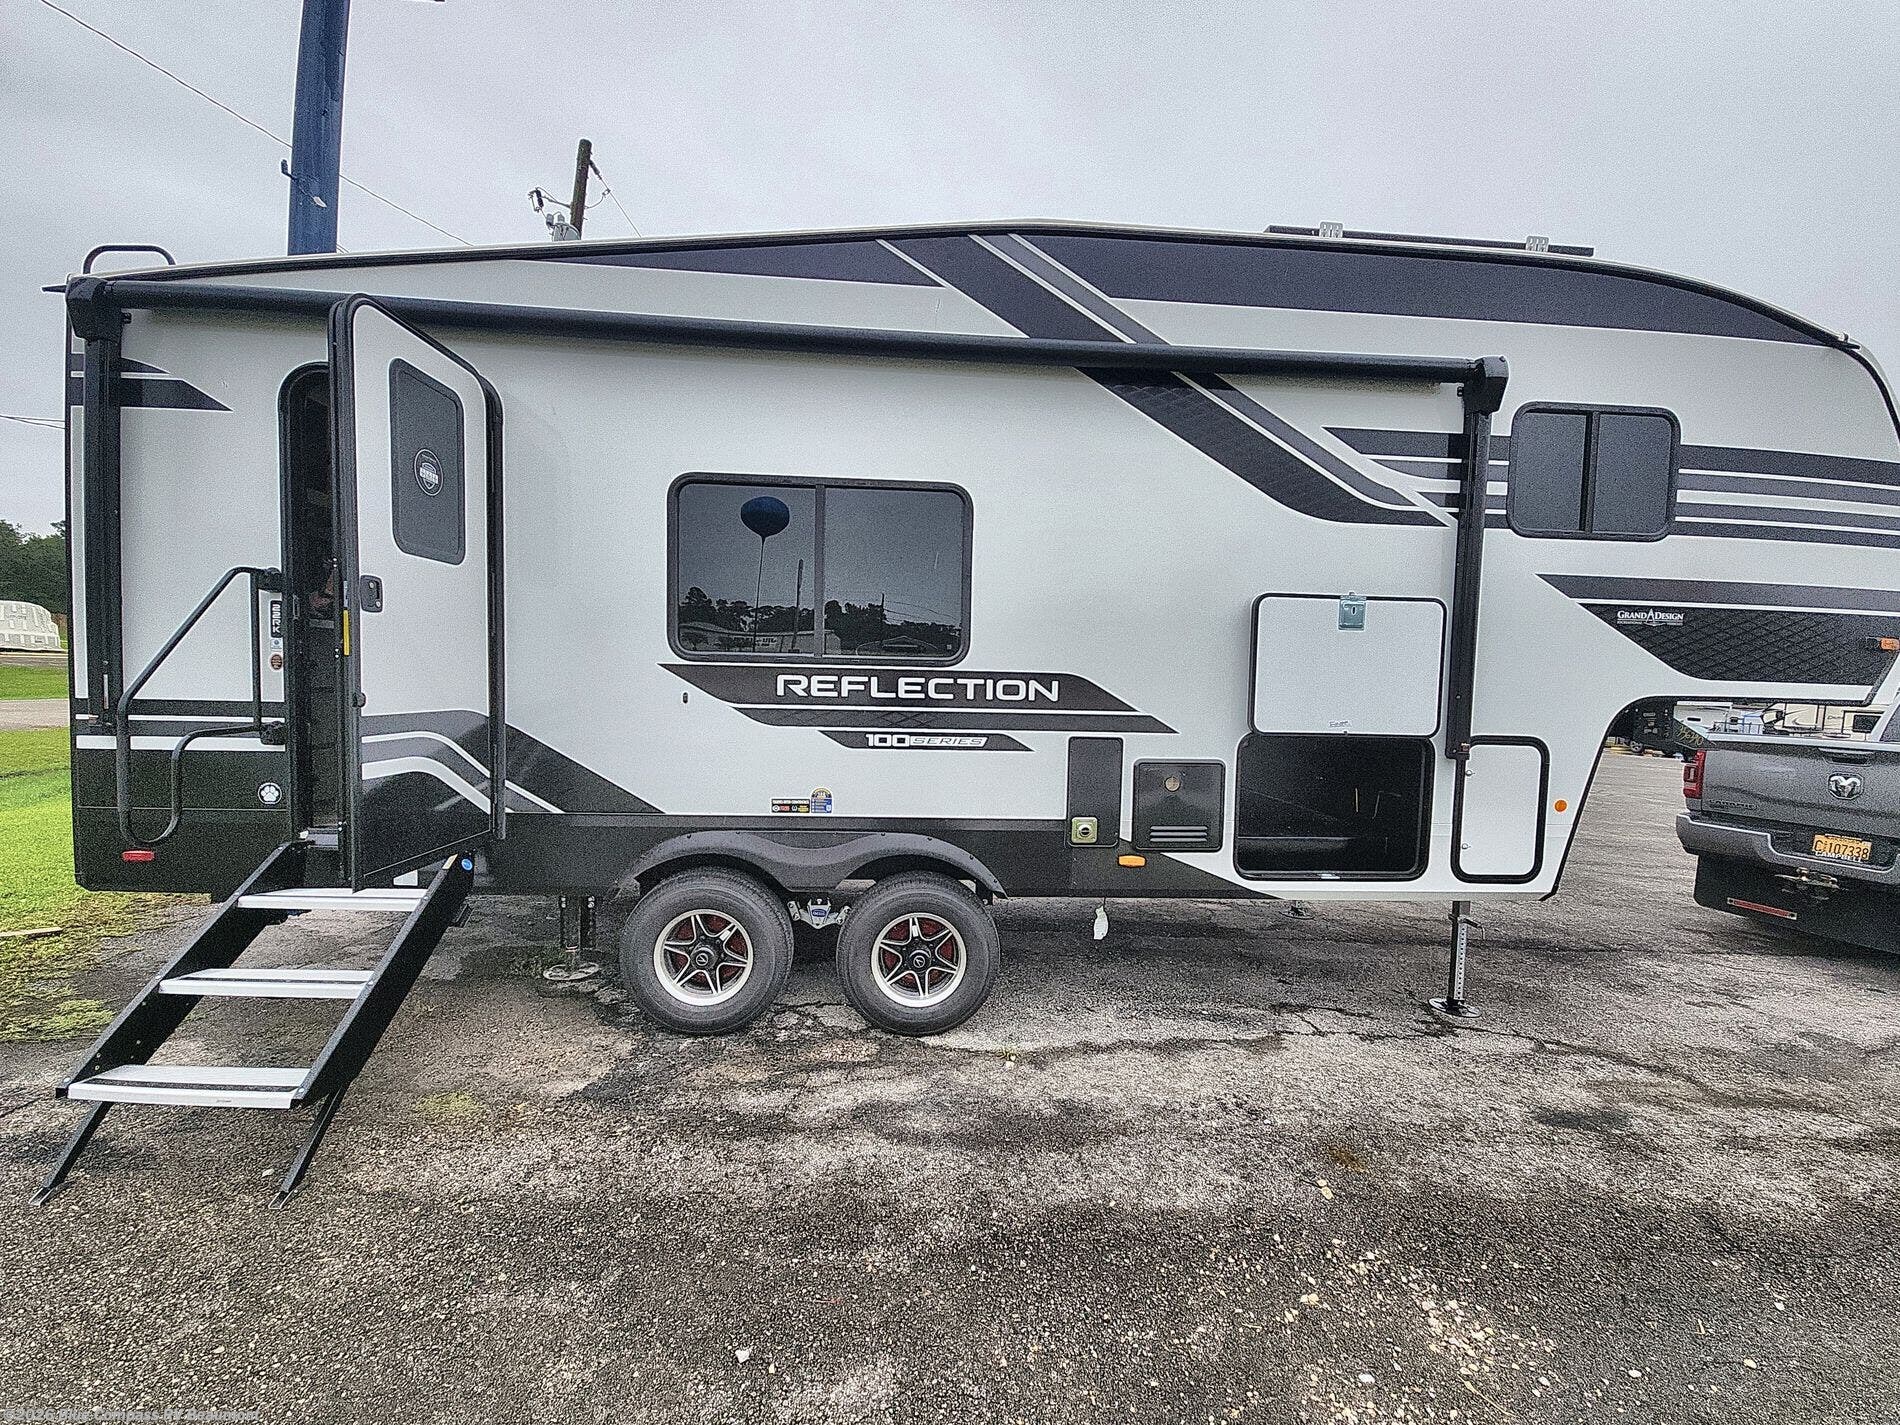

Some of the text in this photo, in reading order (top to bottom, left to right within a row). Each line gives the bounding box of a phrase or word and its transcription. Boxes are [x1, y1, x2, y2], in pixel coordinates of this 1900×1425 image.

[776, 674, 1059, 702] REFLECTION
[866, 733, 985, 747] 100 SERIES
